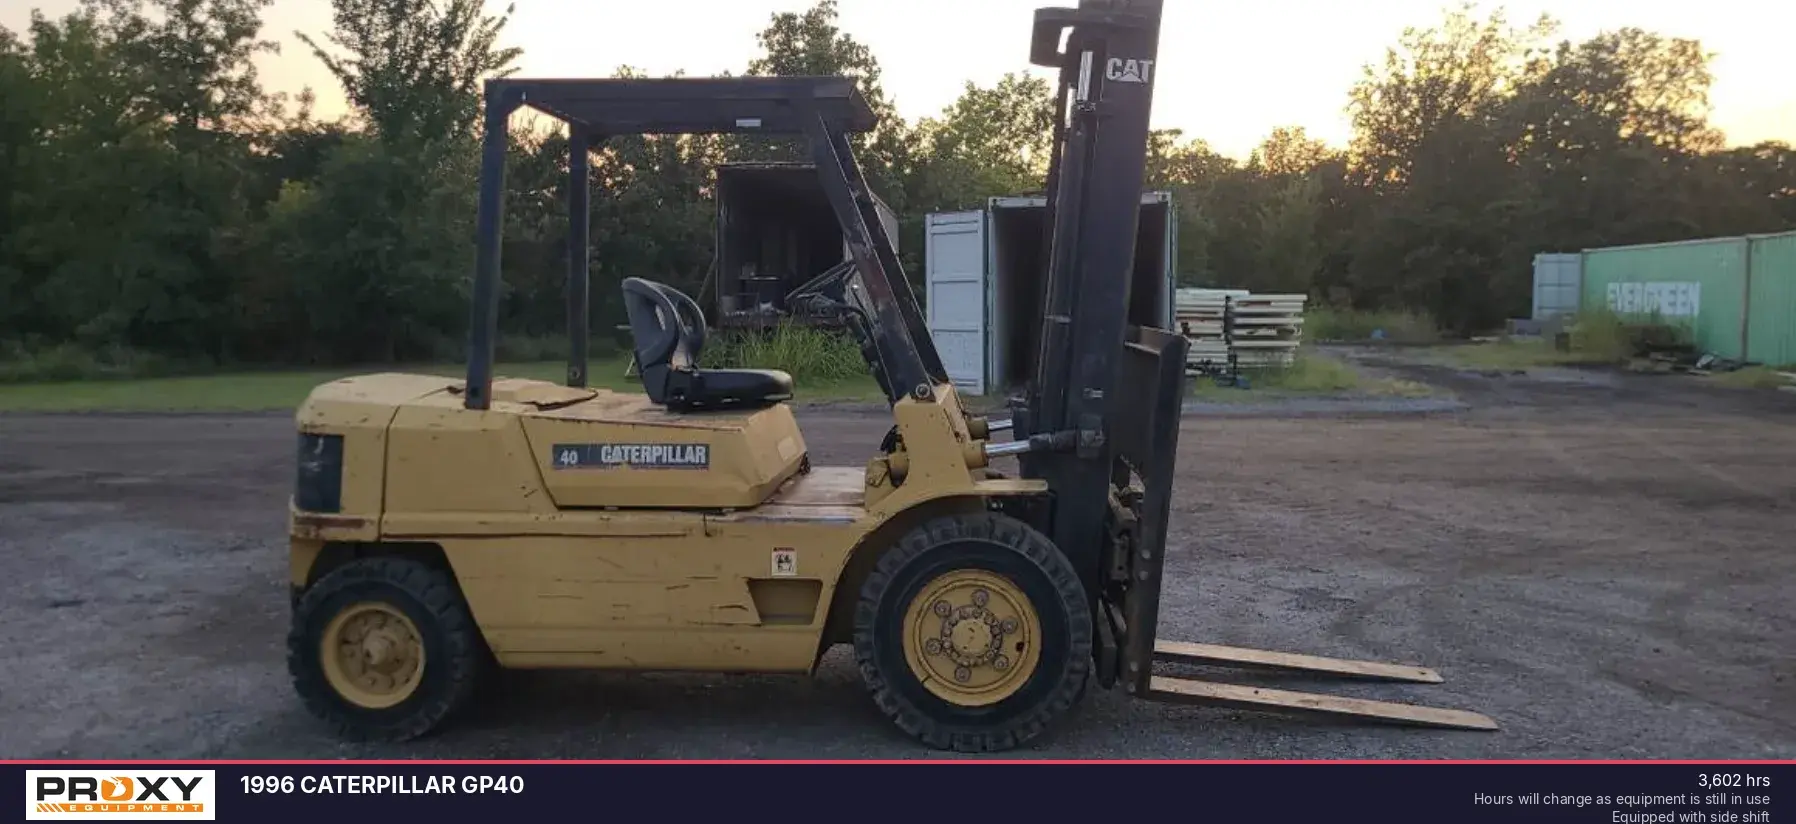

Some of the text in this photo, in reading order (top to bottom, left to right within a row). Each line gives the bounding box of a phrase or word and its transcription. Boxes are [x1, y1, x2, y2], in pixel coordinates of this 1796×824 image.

[1106, 57, 1153, 83] CAT
[560, 446, 706, 465] 40 CATERPILLAR
